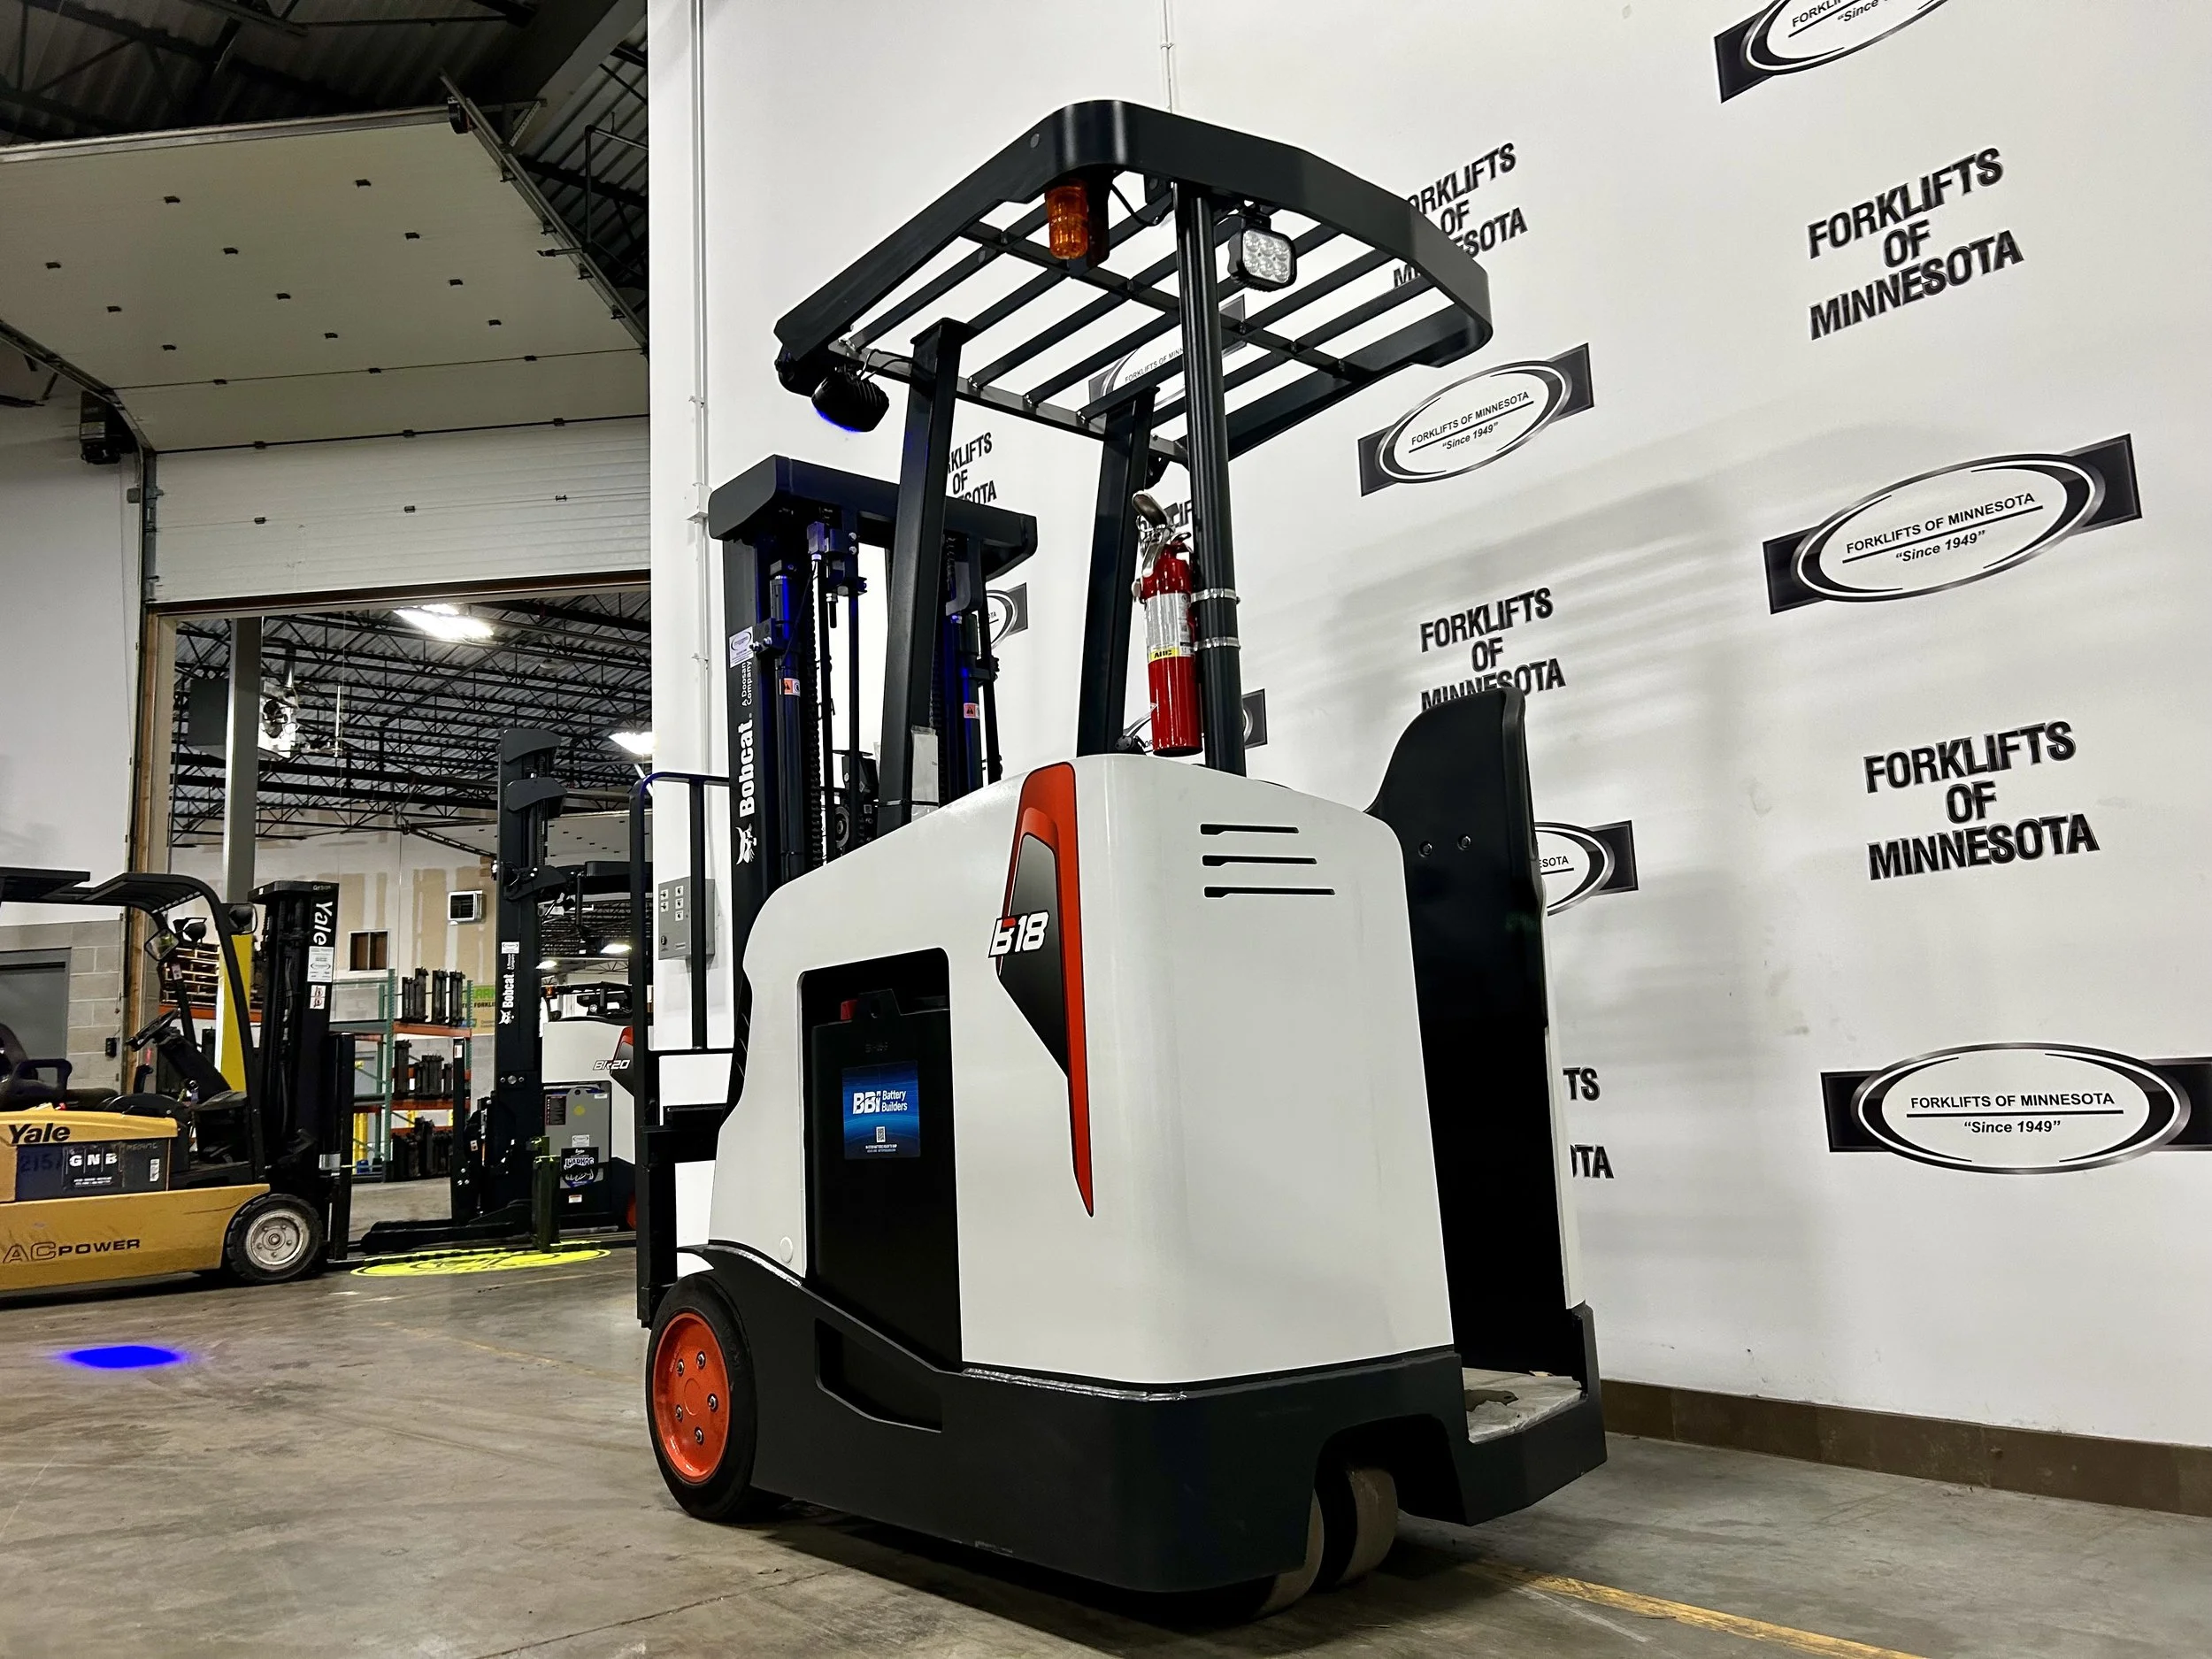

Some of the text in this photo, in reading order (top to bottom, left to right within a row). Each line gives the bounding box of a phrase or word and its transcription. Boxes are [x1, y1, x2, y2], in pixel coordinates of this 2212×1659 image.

[1440, 199, 1471, 236] OF
[1807, 147, 2004, 259] FORKLIFTS
[1883, 219, 1932, 268] OF
[1809, 229, 2024, 341] MINNESOTA
[1411, 391, 1530, 446] FORKLIFTS OF MINNESOTA
[952, 468, 968, 495] OF
[1846, 493, 2035, 554] FORKLIFTS OF MINNESOTA
[1895, 530, 1985, 562] “Since 1949”
[1419, 587, 1554, 653] FORKLIFTS
[1471, 636, 1504, 672] OF
[1863, 720, 2077, 794] FORKLIFTS
[1946, 780, 1997, 825] OF
[1867, 813, 2101, 881] MINNESOTA
[312, 901, 334, 946] Yale
[502, 973, 515, 1009] Bobcat
[881, 1102, 908, 1113] Builders
[882, 1090, 907, 1102] Battery
[1910, 1092, 2116, 1109] FORKLIFTS OF MINNESOTA
[8, 1123, 71, 1144] Yale
[1963, 1120, 2061, 1133] “Since 1949”
[3, 1239, 141, 1264] AC POWER
